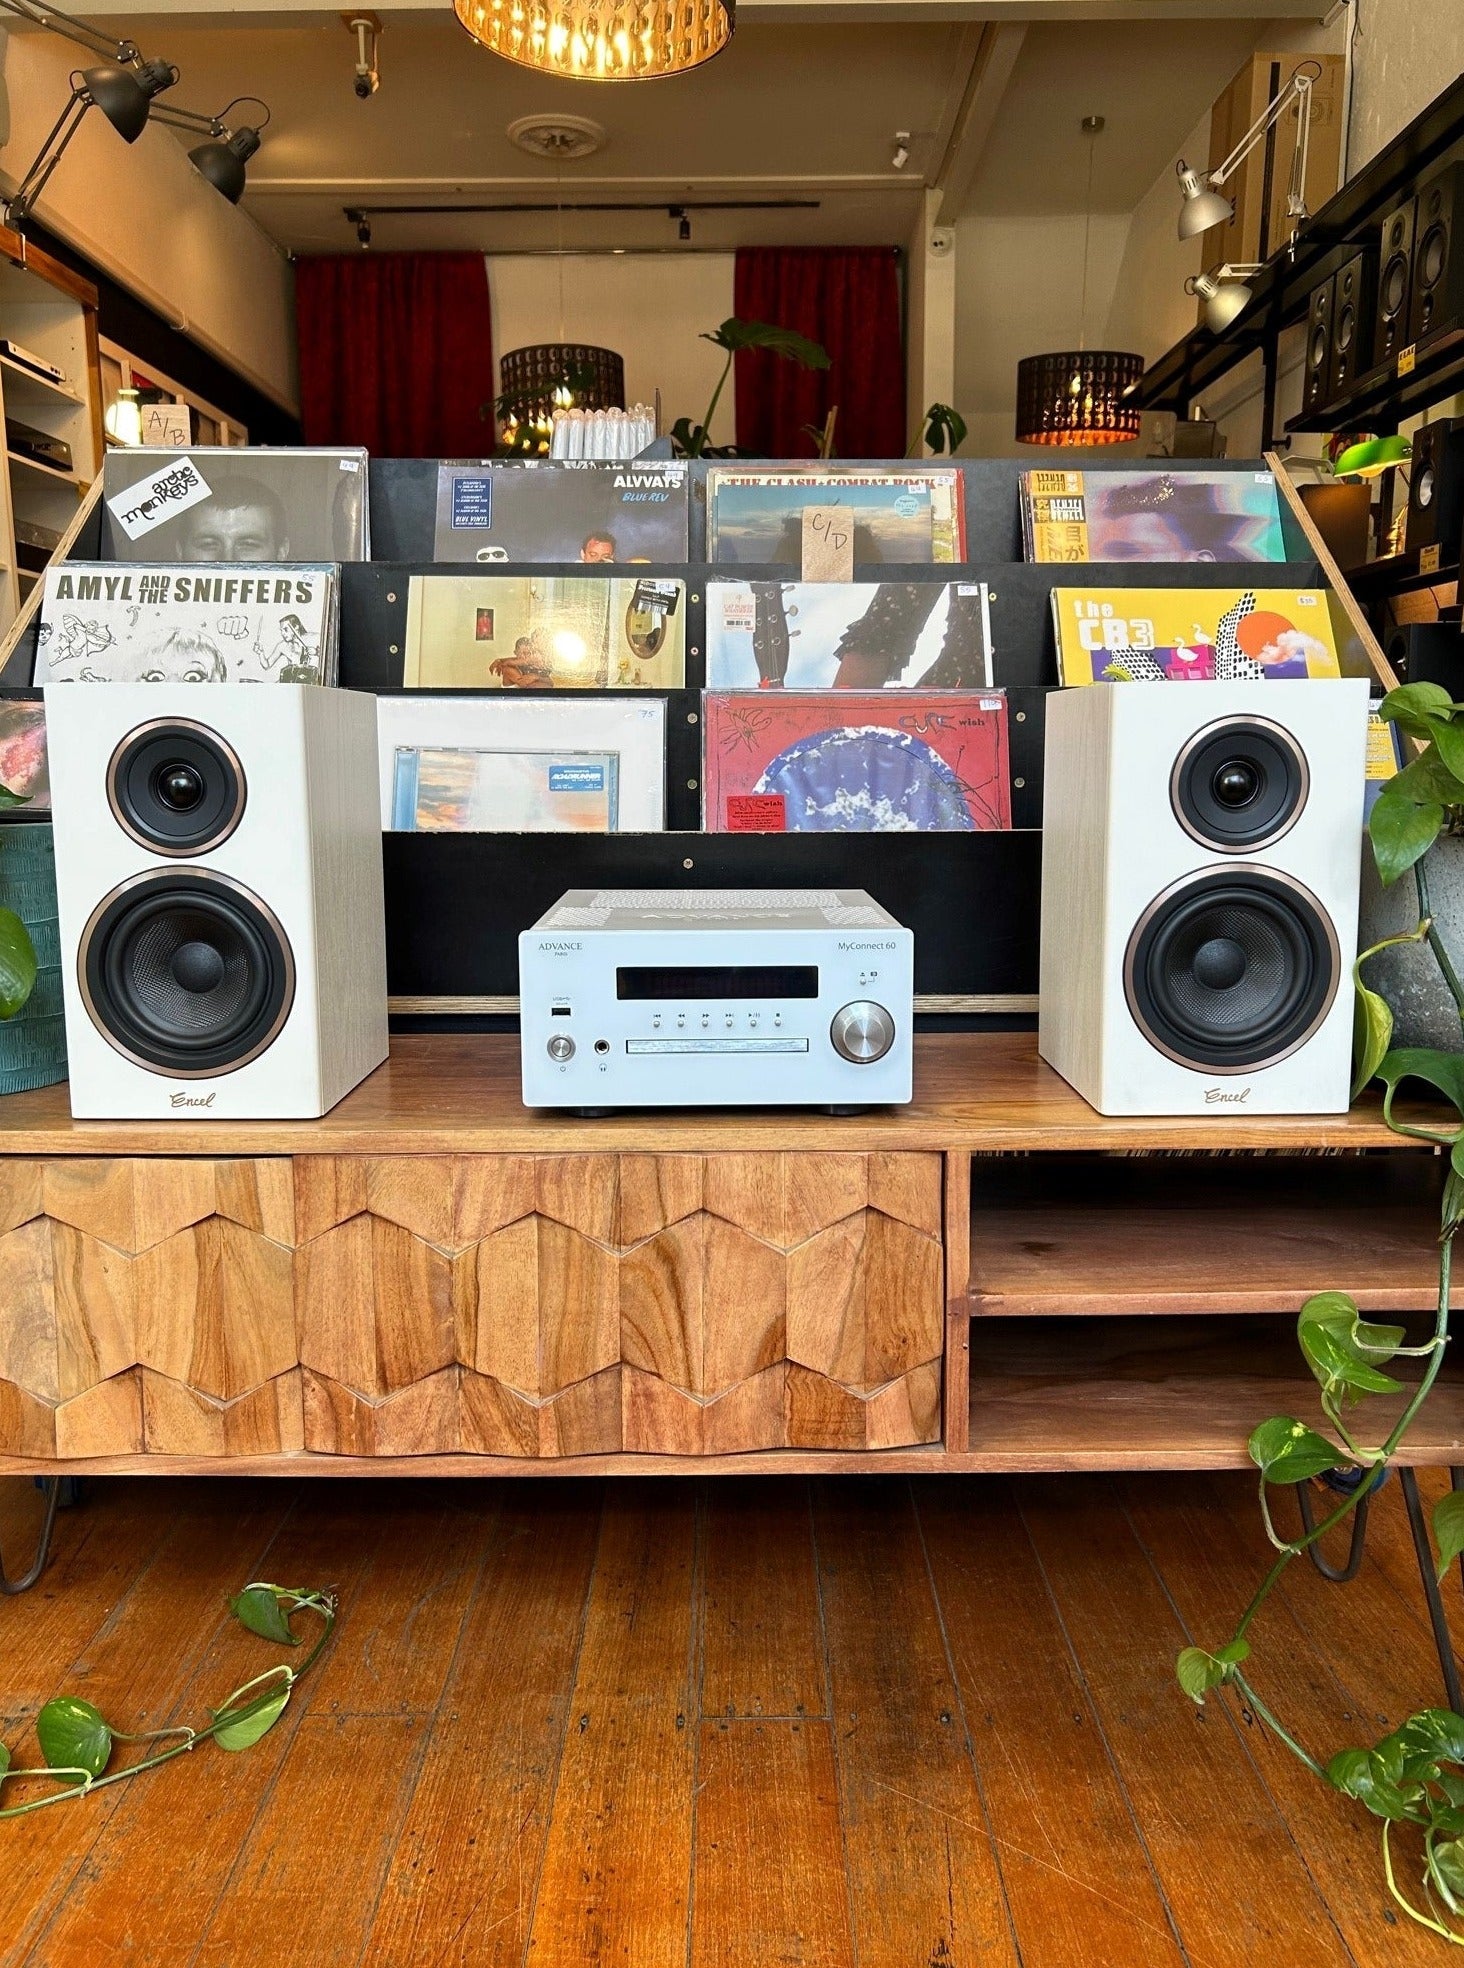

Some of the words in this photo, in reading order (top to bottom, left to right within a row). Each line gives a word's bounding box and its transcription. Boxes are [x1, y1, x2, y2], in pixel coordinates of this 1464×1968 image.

[148, 410, 186, 446] A/B
[152, 466, 193, 494] arctic
[613, 474, 682, 489] ALVVAYS
[121, 474, 199, 523] monkeys
[622, 492, 649, 502] BLUE
[812, 513, 848, 550] C/D
[56, 574, 133, 601] AMYL
[140, 575, 171, 588] AND
[139, 588, 168, 604] THE
[174, 577, 313, 604] SNIFFERS
[1074, 599, 1113, 618] the
[1078, 618, 1155, 650] CB3
[958, 717, 985, 727] wish
[538, 942, 583, 951] ADVANCE
[838, 942, 884, 951] MyConnect
[885, 941, 897, 950] 60
[169, 1091, 216, 1108] Encel
[1203, 1087, 1251, 1104] Encel
